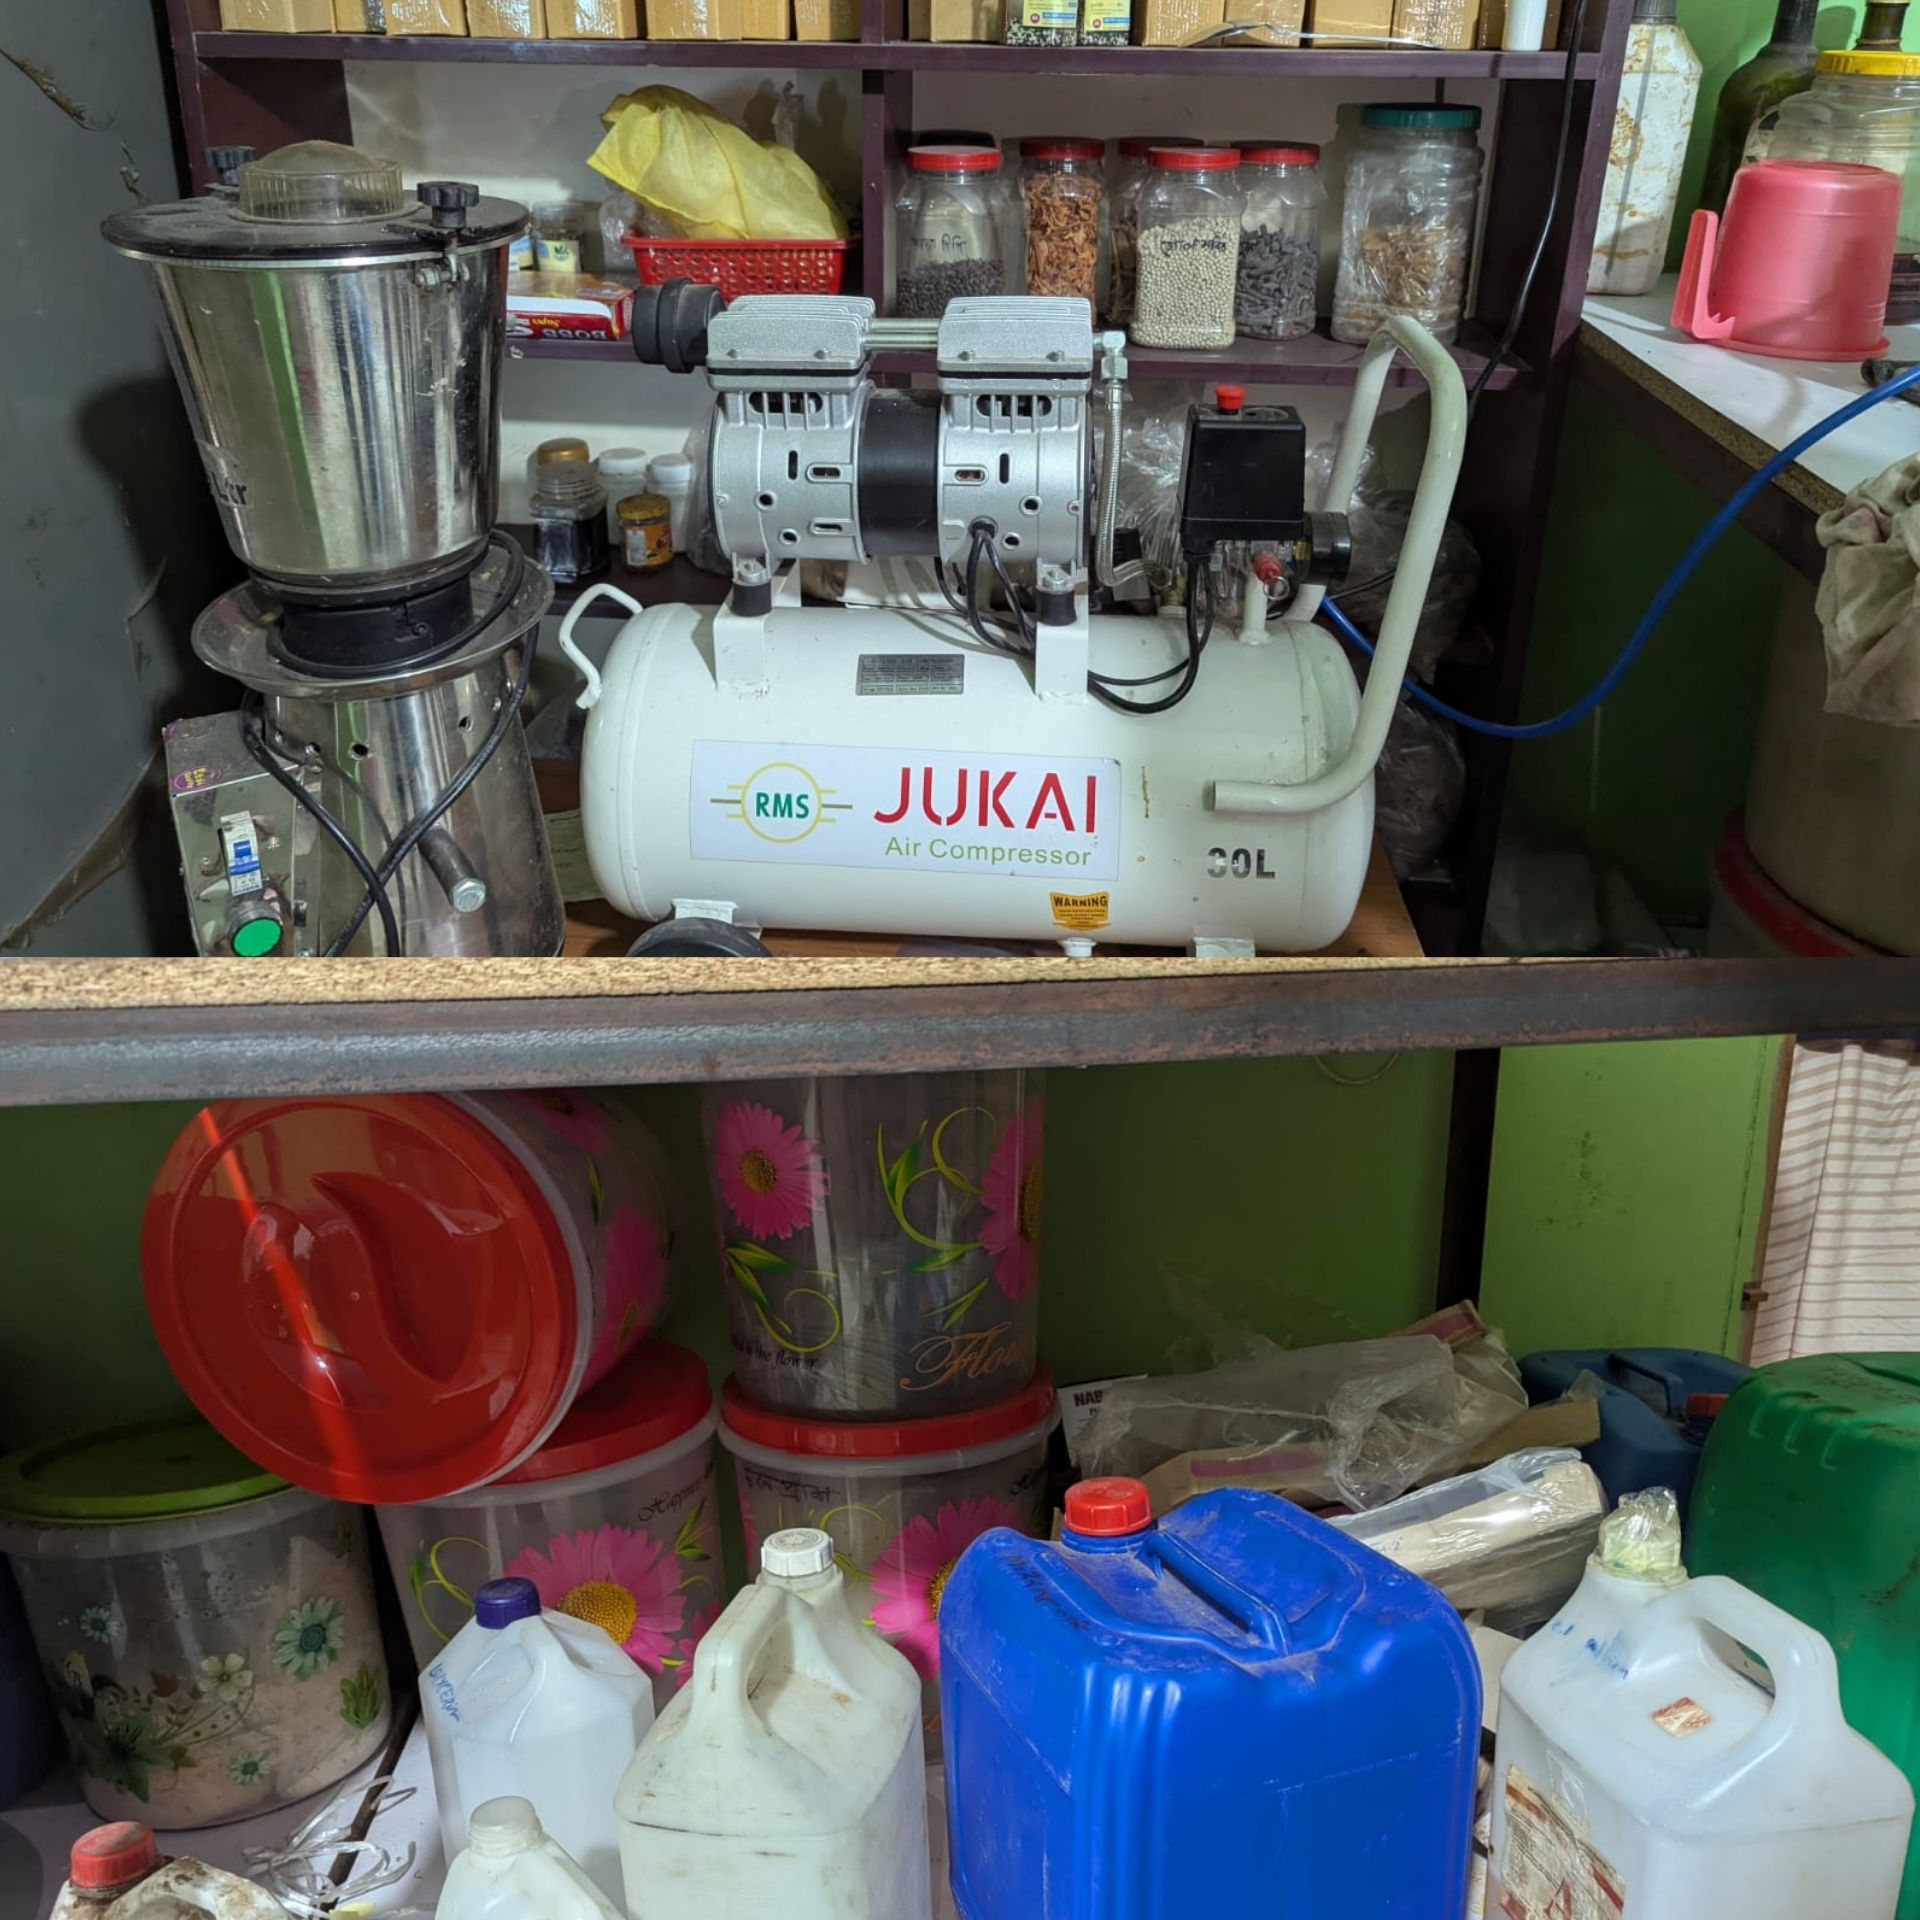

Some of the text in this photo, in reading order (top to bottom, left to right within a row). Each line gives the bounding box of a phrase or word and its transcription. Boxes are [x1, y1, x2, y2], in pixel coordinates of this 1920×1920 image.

[755, 791, 810, 819] RMS
[873, 766, 1097, 833] JUKAI
[885, 836, 1092, 866] Air Compressor
[1053, 895, 1107, 907] WARNING
